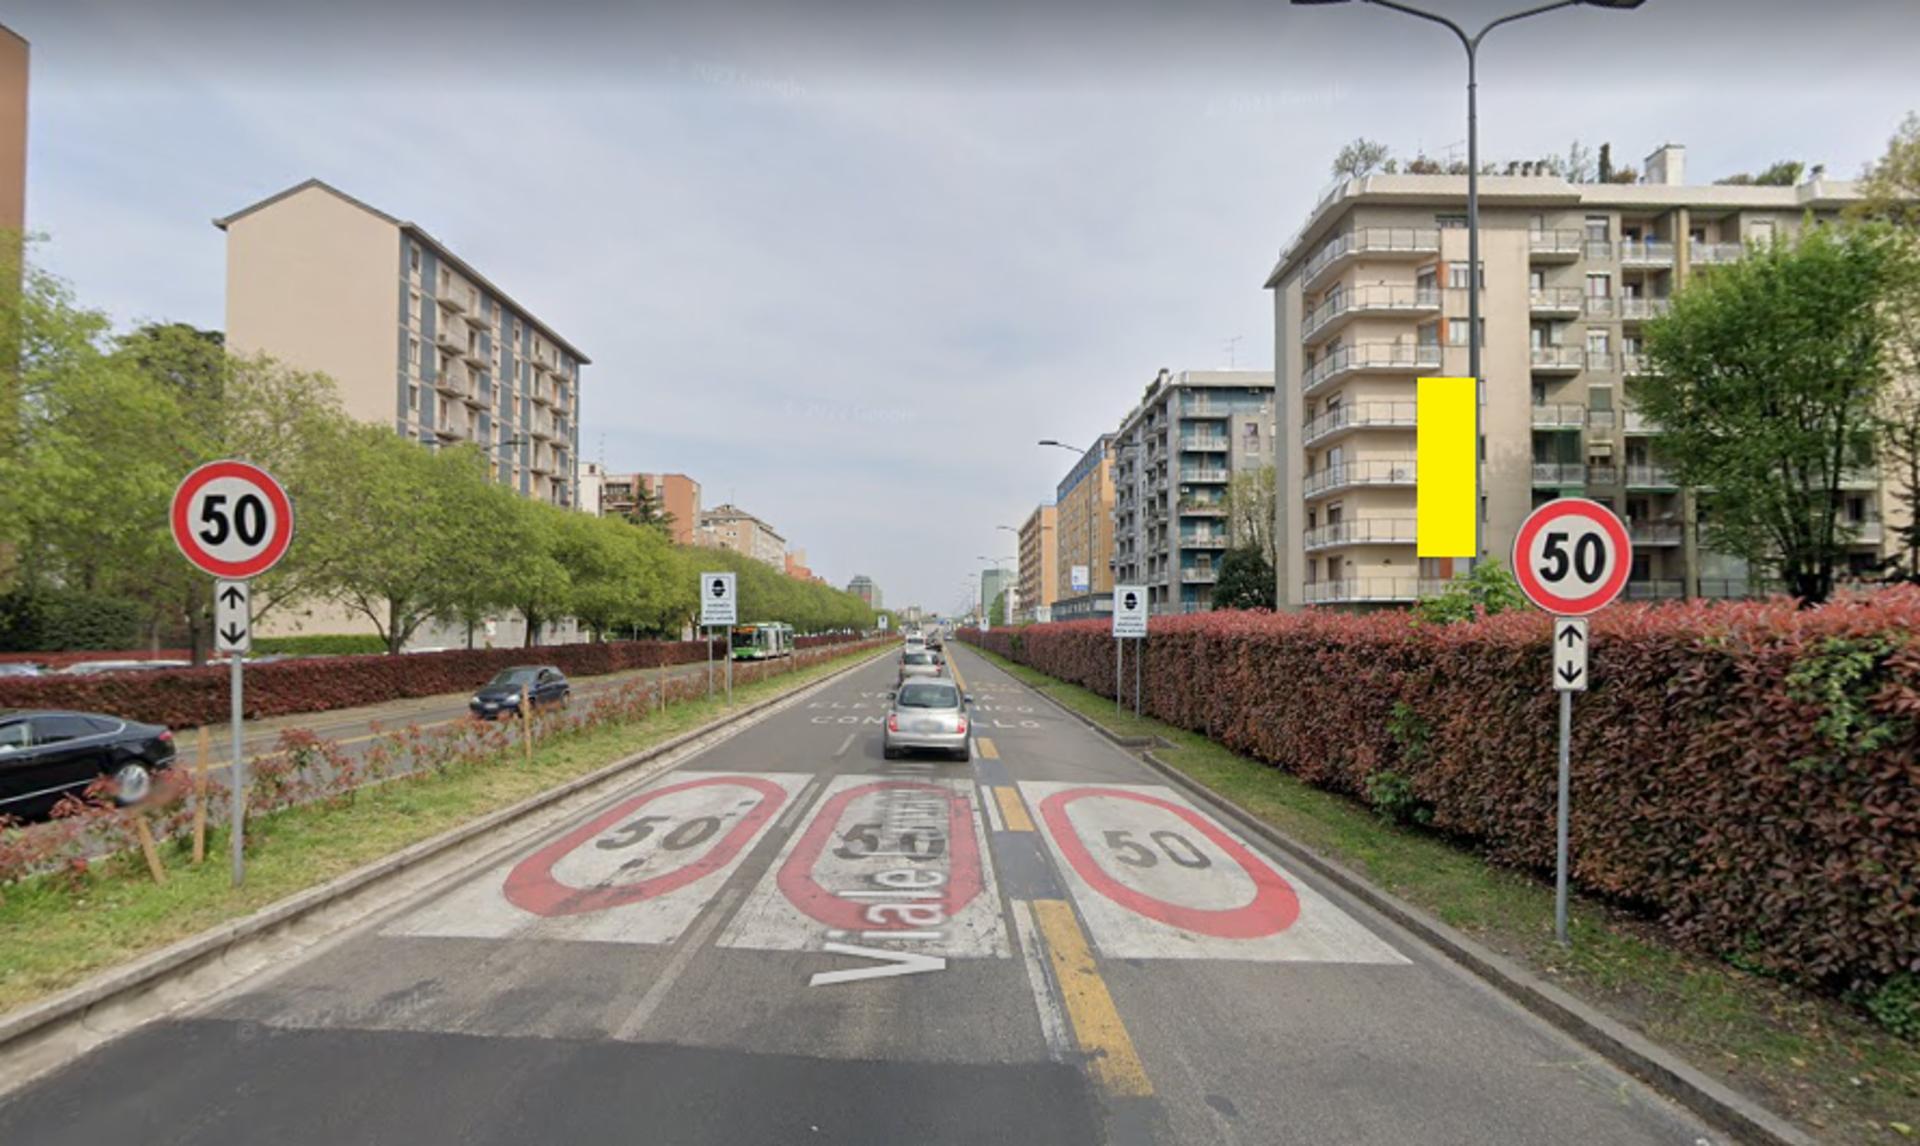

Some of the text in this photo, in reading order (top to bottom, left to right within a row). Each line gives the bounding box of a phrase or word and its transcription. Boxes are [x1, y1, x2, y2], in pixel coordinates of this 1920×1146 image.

[199, 493, 267, 546] 50
[1539, 532, 1606, 583] 50
[596, 816, 721, 851] 50
[1102, 830, 1212, 869] 50
